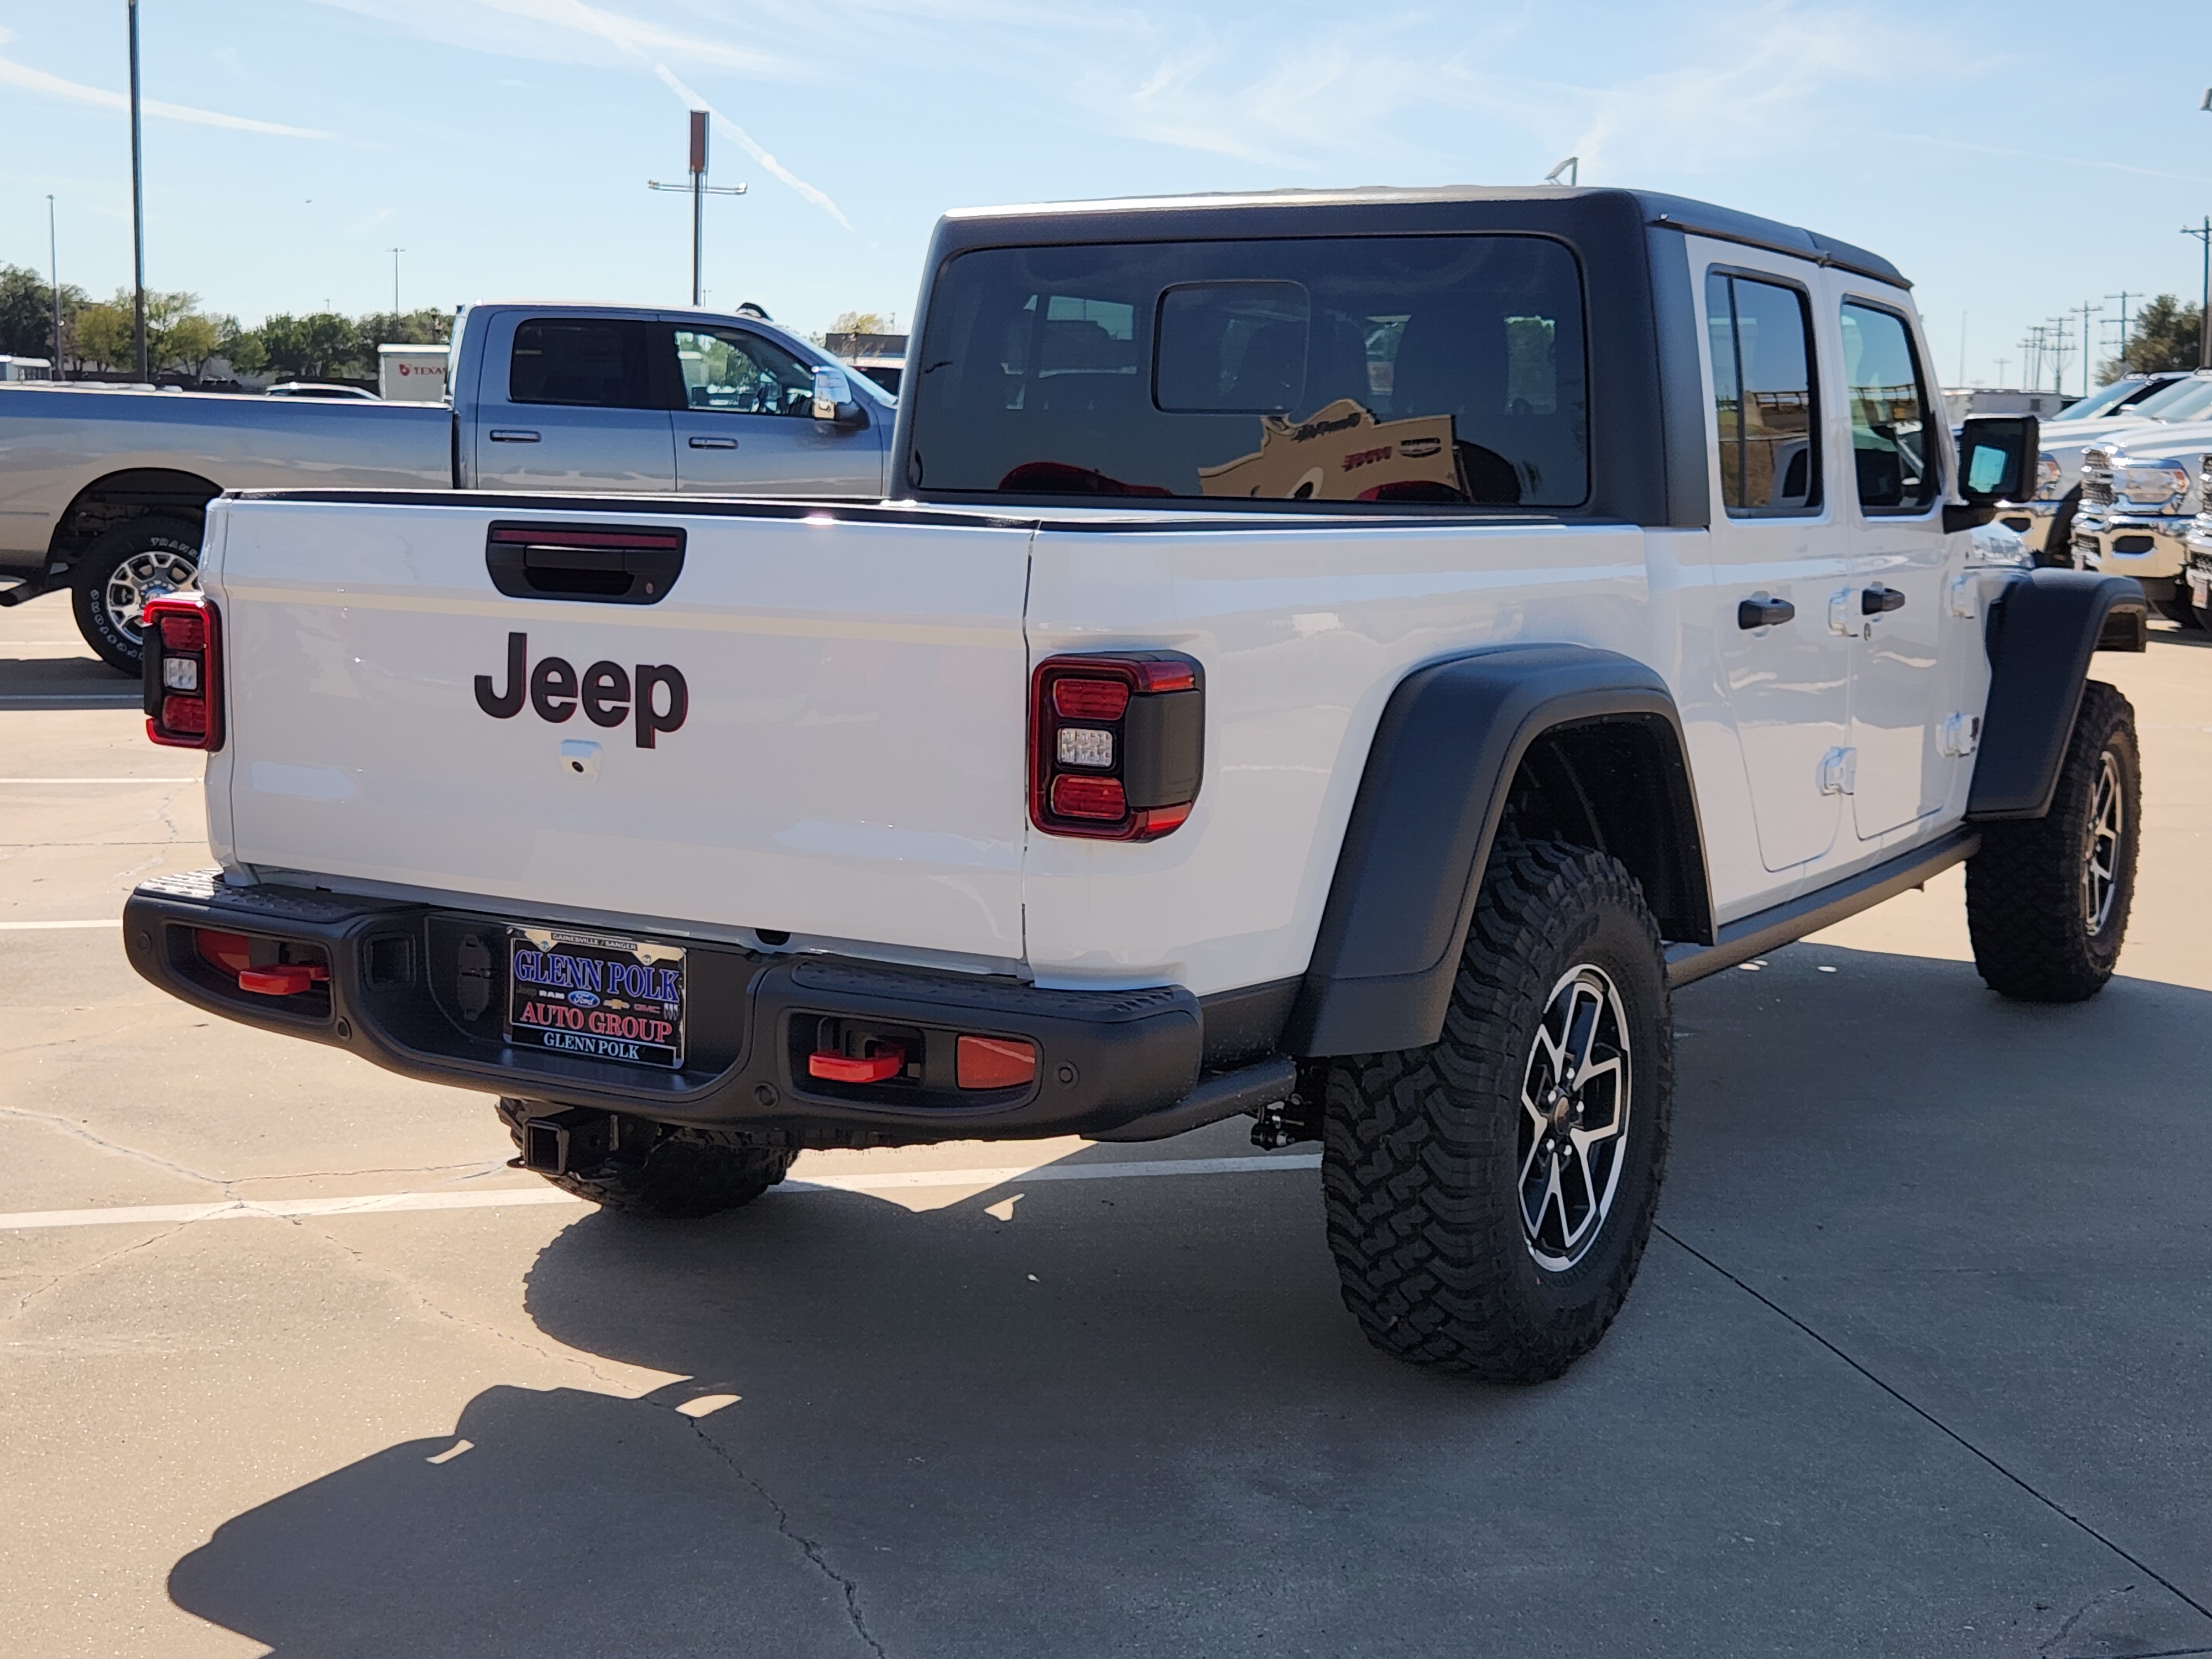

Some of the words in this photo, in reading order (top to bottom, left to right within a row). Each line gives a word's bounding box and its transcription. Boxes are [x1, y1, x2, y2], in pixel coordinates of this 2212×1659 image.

[474, 632, 689, 749] Jeep
[552, 933, 599, 945] GAINESVILLE
[605, 941, 636, 950] SANGER
[514, 950, 603, 992] GLENN
[607, 961, 680, 1003] POLK
[539, 989, 565, 1000] RAM
[573, 993, 594, 1006] Ford
[520, 1001, 584, 1030] AUTO
[588, 1010, 672, 1043] GROUP
[543, 1032, 596, 1052] GLENN
[597, 1039, 640, 1060] POLK
